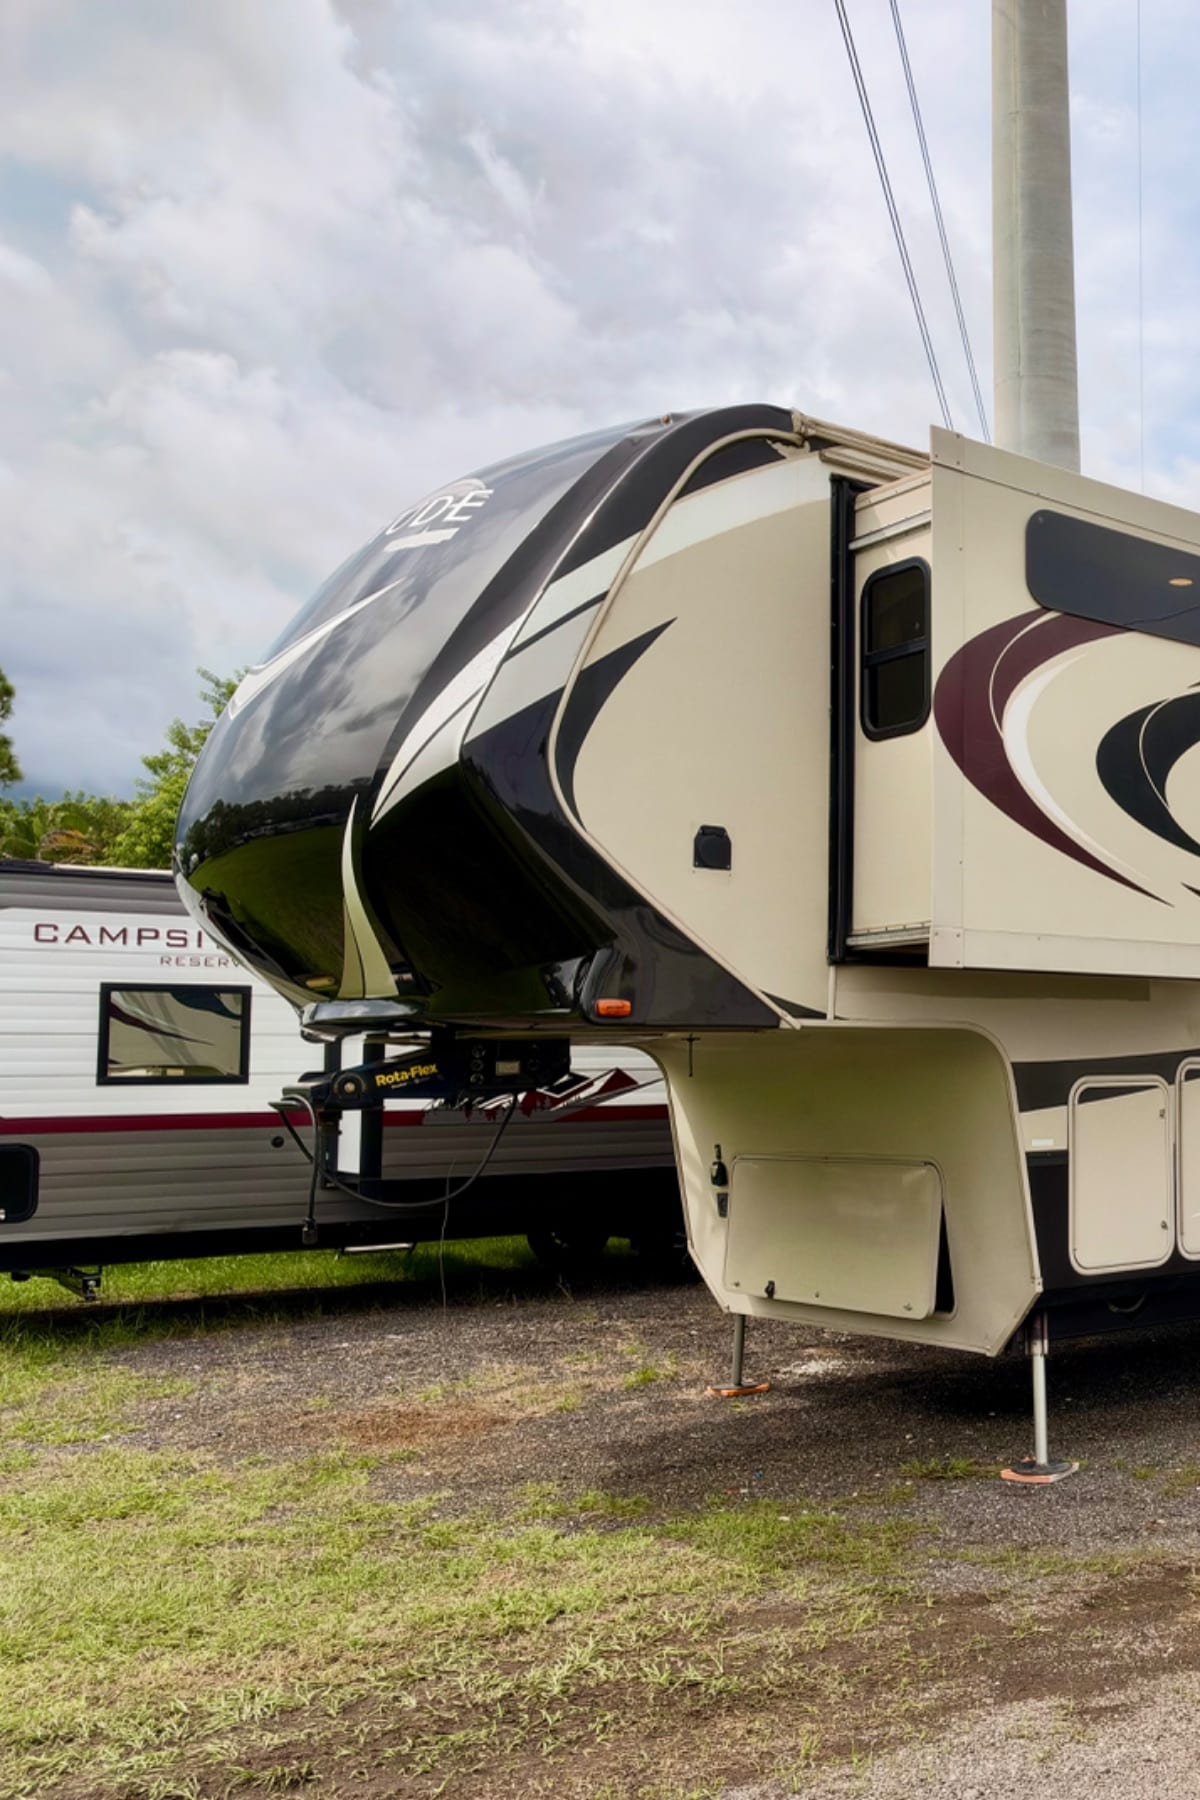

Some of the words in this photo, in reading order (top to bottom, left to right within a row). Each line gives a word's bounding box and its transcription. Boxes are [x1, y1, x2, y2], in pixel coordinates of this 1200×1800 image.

[385, 489, 494, 535] UDE
[34, 923, 220, 949] CAMPSI
[160, 956, 240, 968] RESERV
